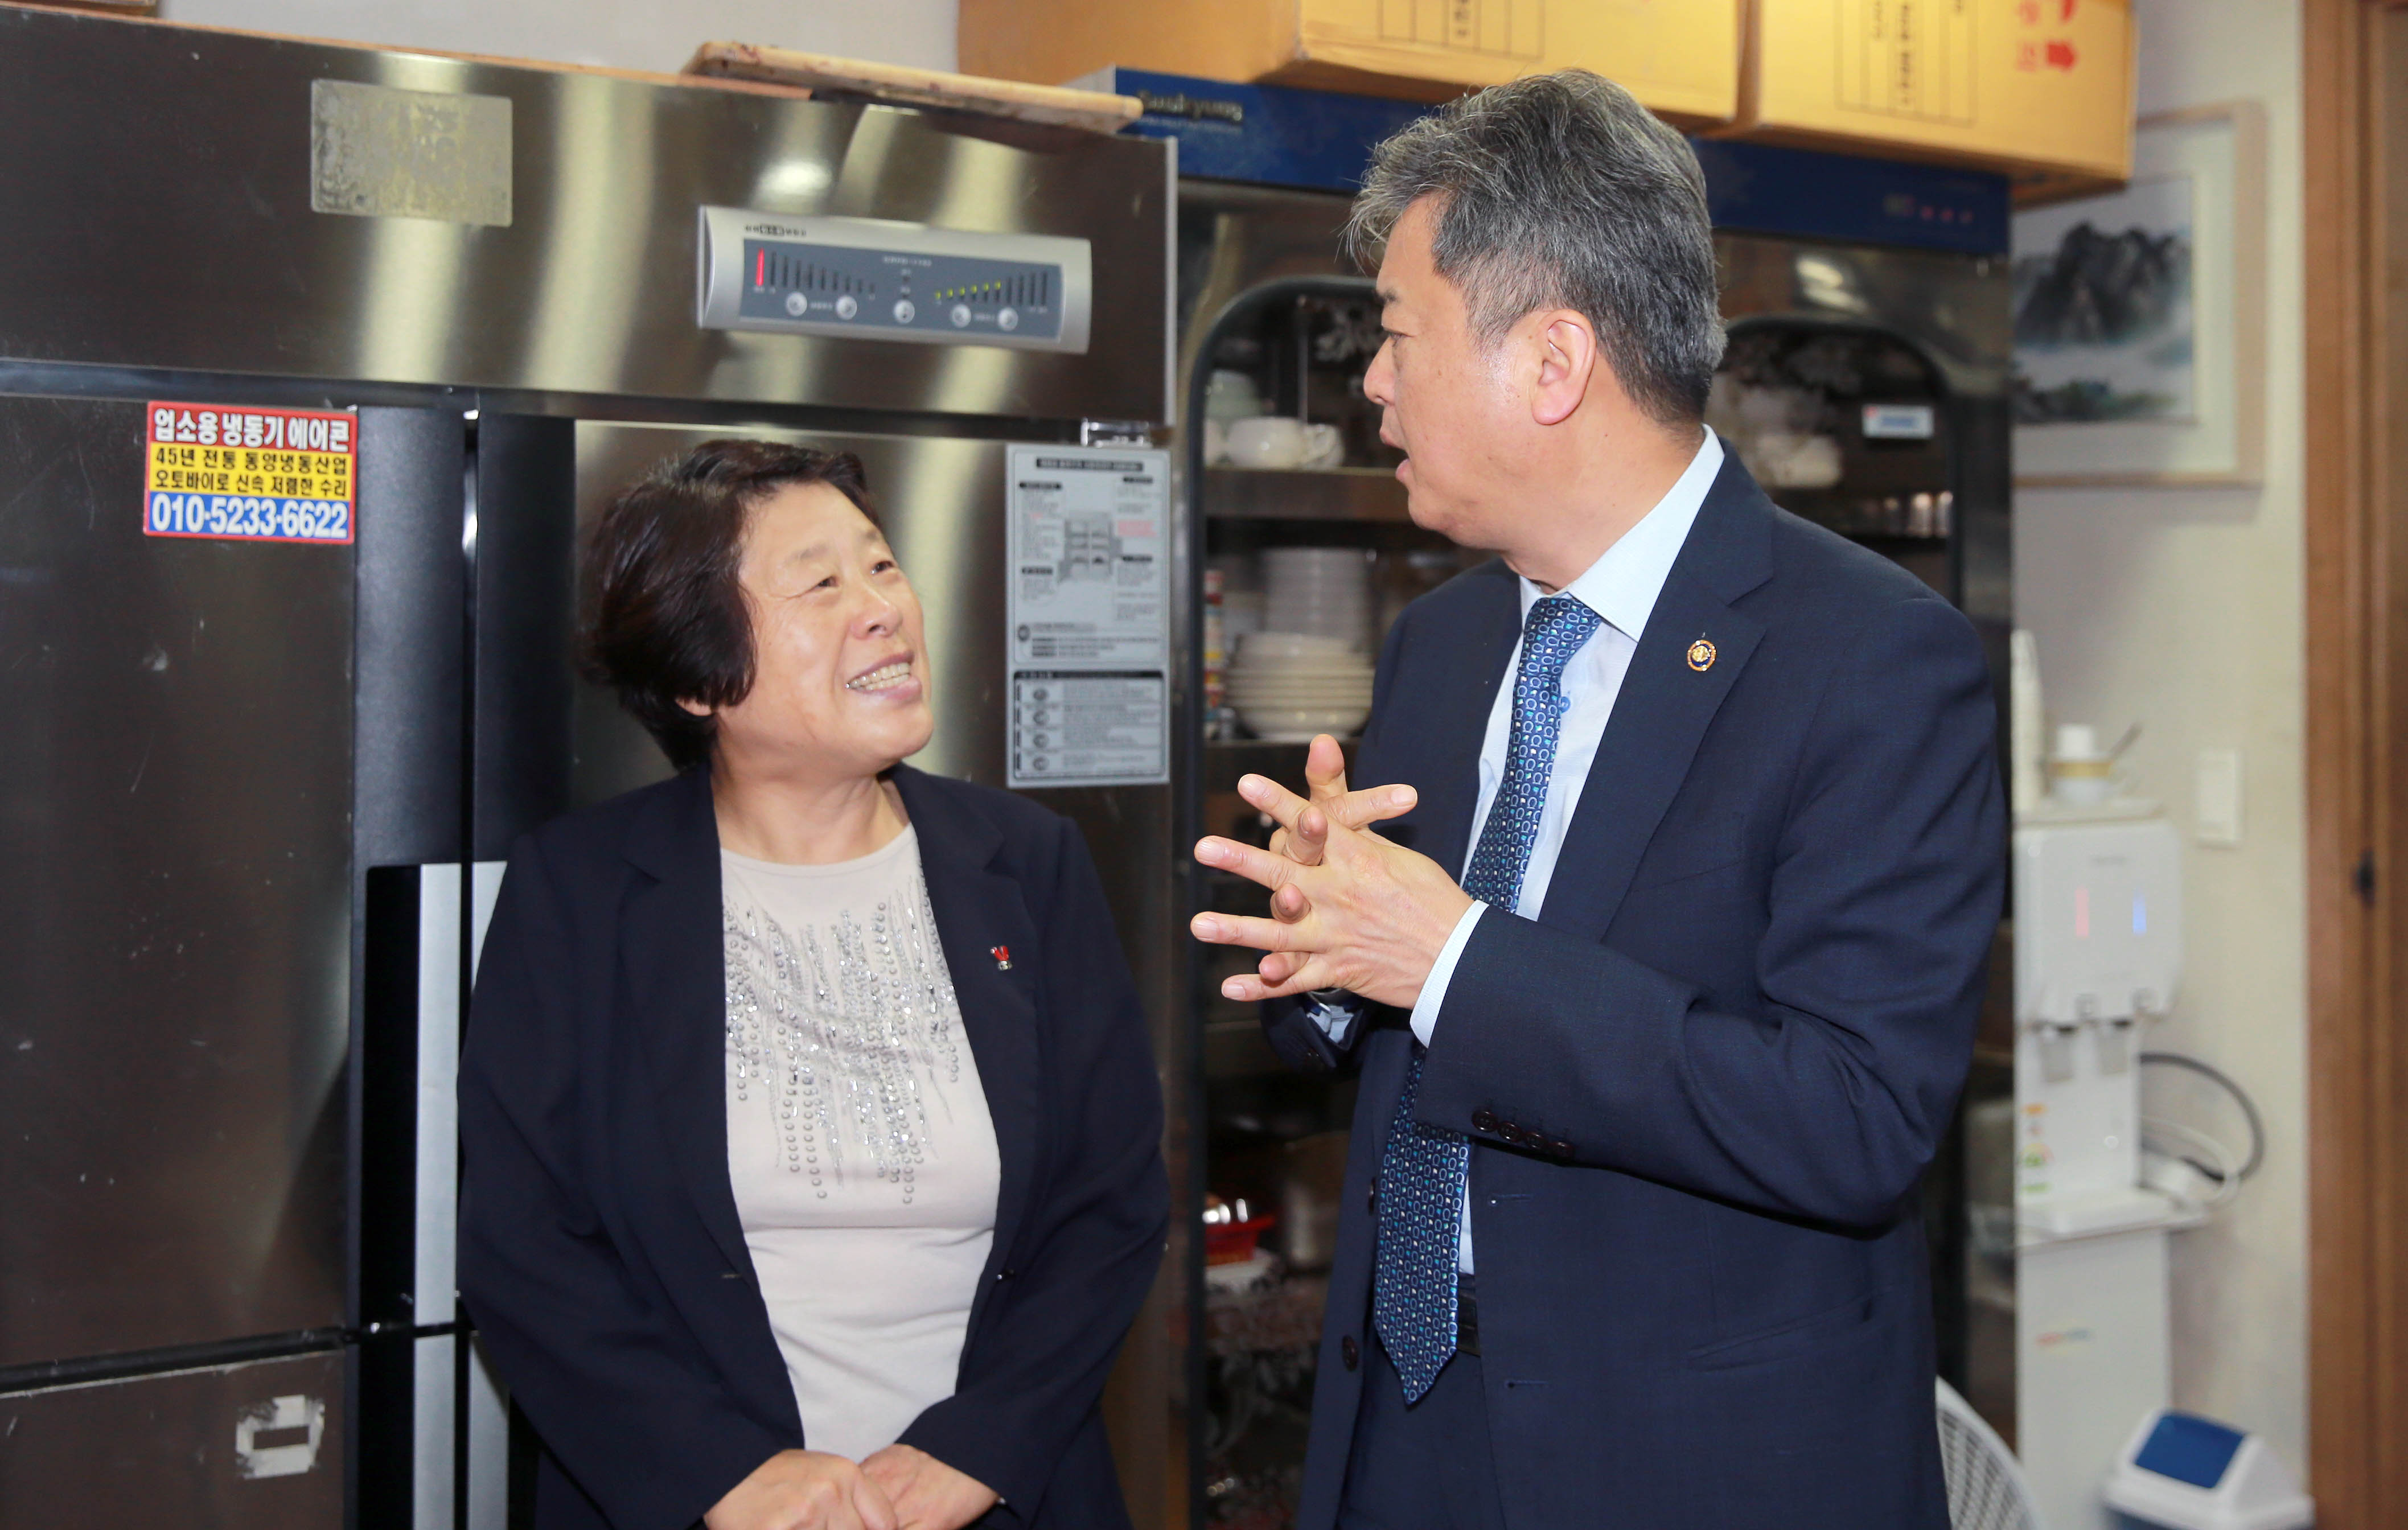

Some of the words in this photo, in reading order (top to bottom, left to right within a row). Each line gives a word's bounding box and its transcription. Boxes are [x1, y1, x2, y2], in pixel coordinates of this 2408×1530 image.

[154, 408, 219, 445] 업소용
[221, 412, 284, 449] 냉동기
[155, 447, 195, 467] 45년
[203, 449, 236, 470] 전통
[245, 451, 347, 476] 동양냉동산업
[155, 469, 229, 491] 오토바이로
[236, 473, 264, 494] 신속
[270, 476, 313, 496] 저렴한
[319, 478, 347, 497] 수리
[151, 493, 348, 538] 010-5233-6622
